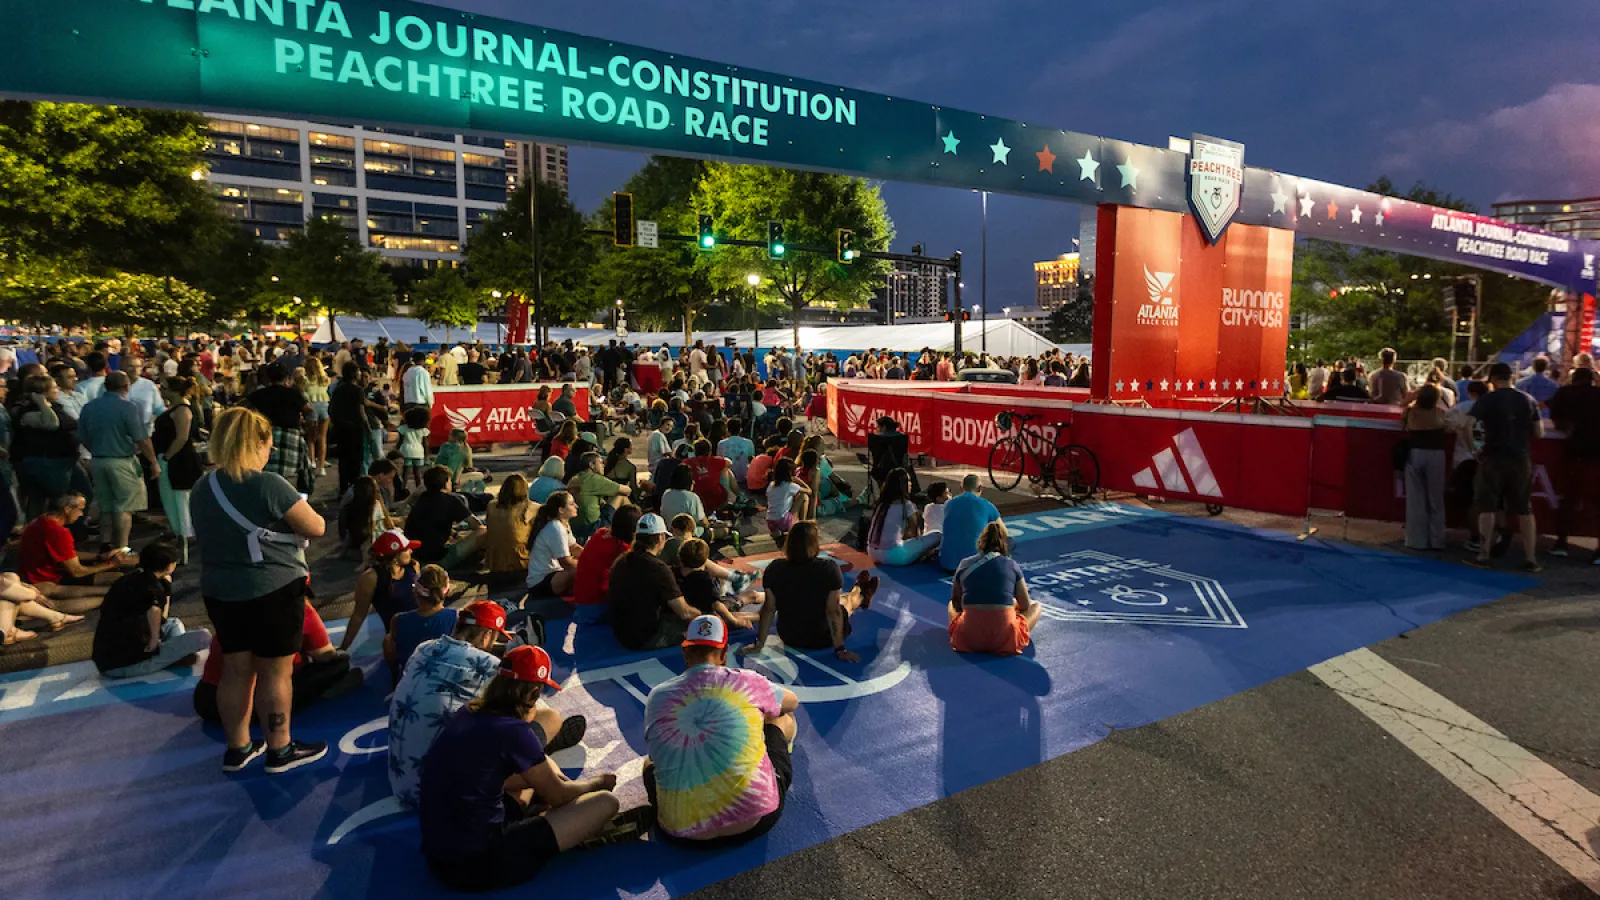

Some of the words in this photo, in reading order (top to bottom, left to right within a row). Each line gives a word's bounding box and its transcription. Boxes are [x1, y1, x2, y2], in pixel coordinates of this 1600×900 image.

[369, 10, 857, 126] JOURNAL-CONSTITUTION
[275, 38, 545, 113] PEACHTREE
[562, 86, 670, 131] ROAD
[684, 106, 769, 146] RACE
[1191, 160, 1241, 181] PEACHTREE
[1431, 213, 1474, 235] ATLANTA
[1456, 237, 1505, 258] PEACHTREE
[1505, 246, 1529, 263] ROAD
[1529, 249, 1549, 265] RACE
[1222, 287, 1284, 309] RUNNING
[1137, 303, 1179, 319] ATLANTA
[1221, 307, 1253, 327] CITY
[1259, 309, 1283, 328] USA
[486, 406, 533, 422] ATLA
[487, 423, 525, 431] TRACK
